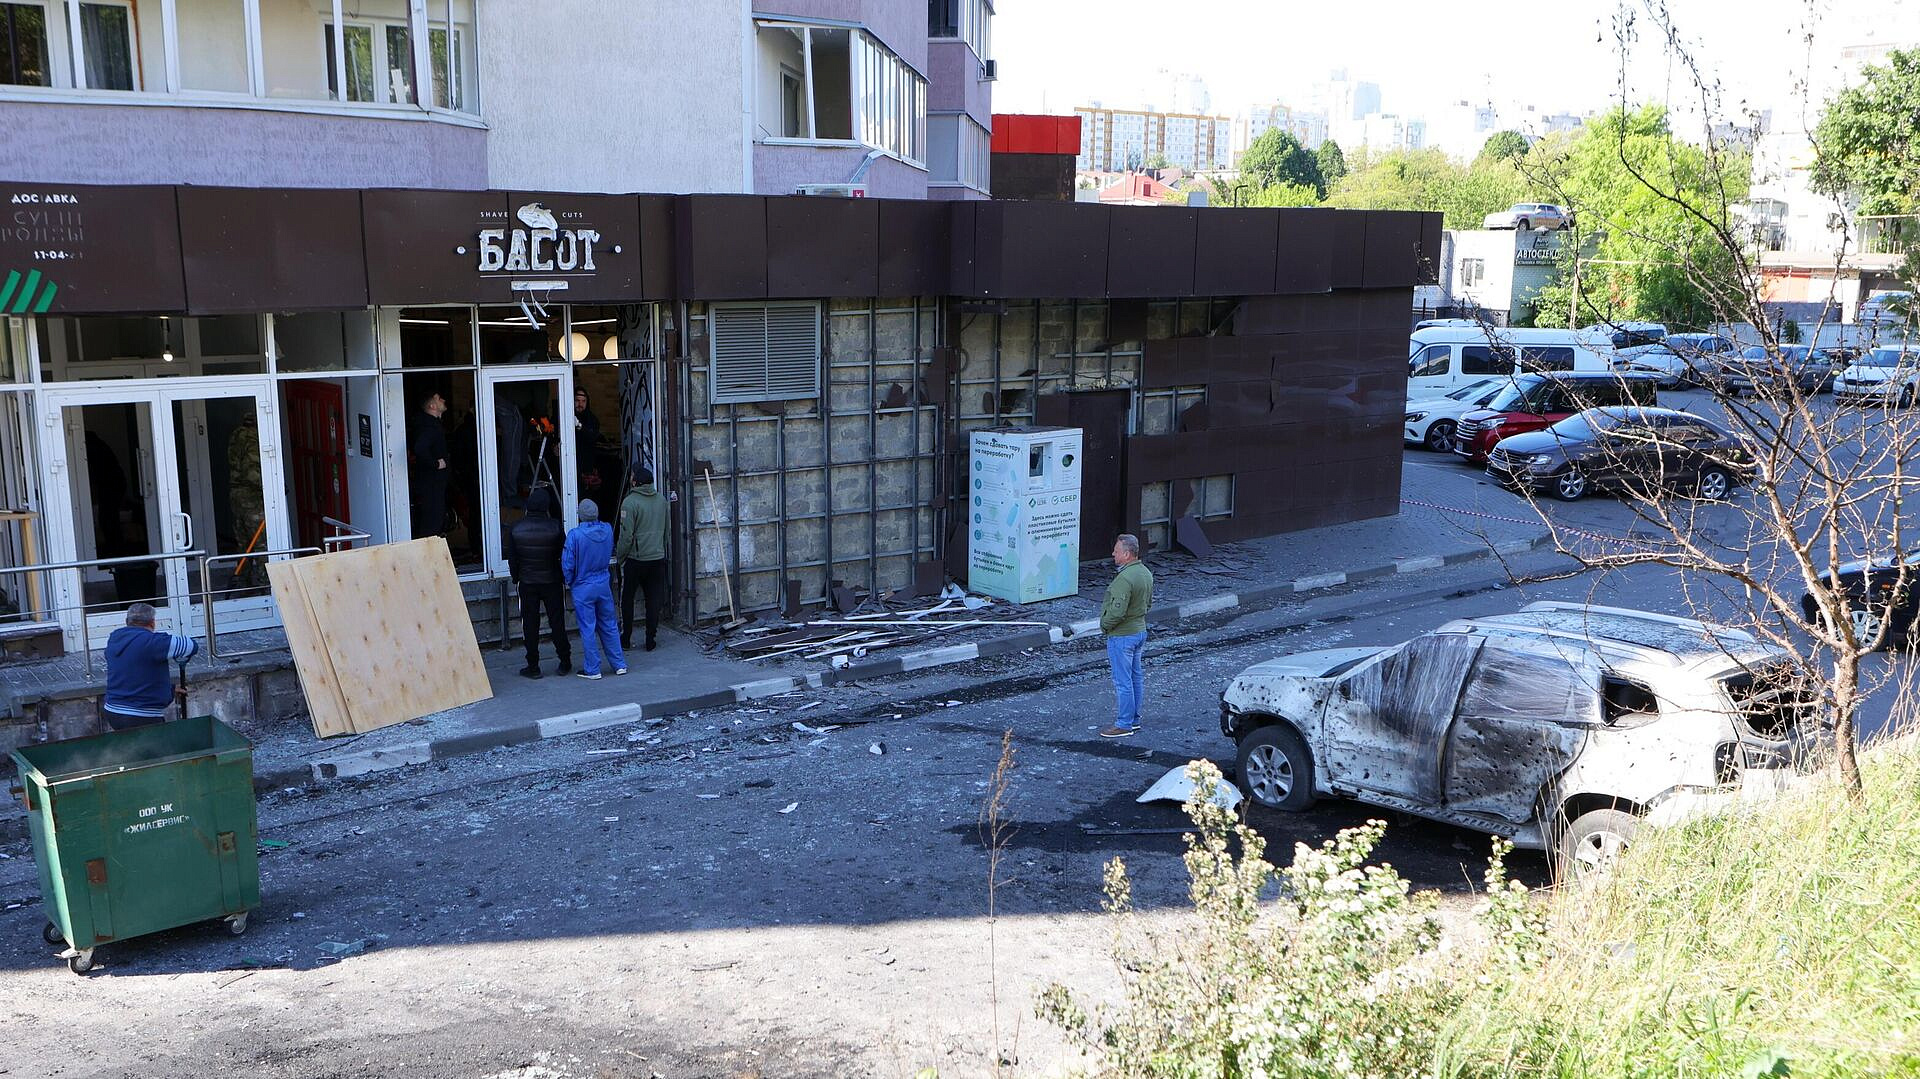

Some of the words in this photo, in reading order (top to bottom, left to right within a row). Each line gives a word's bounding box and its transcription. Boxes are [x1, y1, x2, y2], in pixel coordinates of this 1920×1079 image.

[478, 229, 600, 272] БАСОТ
[1517, 249, 1562, 259] АВТОСТЕКЛ
[1060, 494, 1077, 503] СБЕР
[139, 806, 157, 818] ООО
[160, 803, 173, 813] УК
[124, 815, 191, 833] «ЖИЛСЕРВИС»
